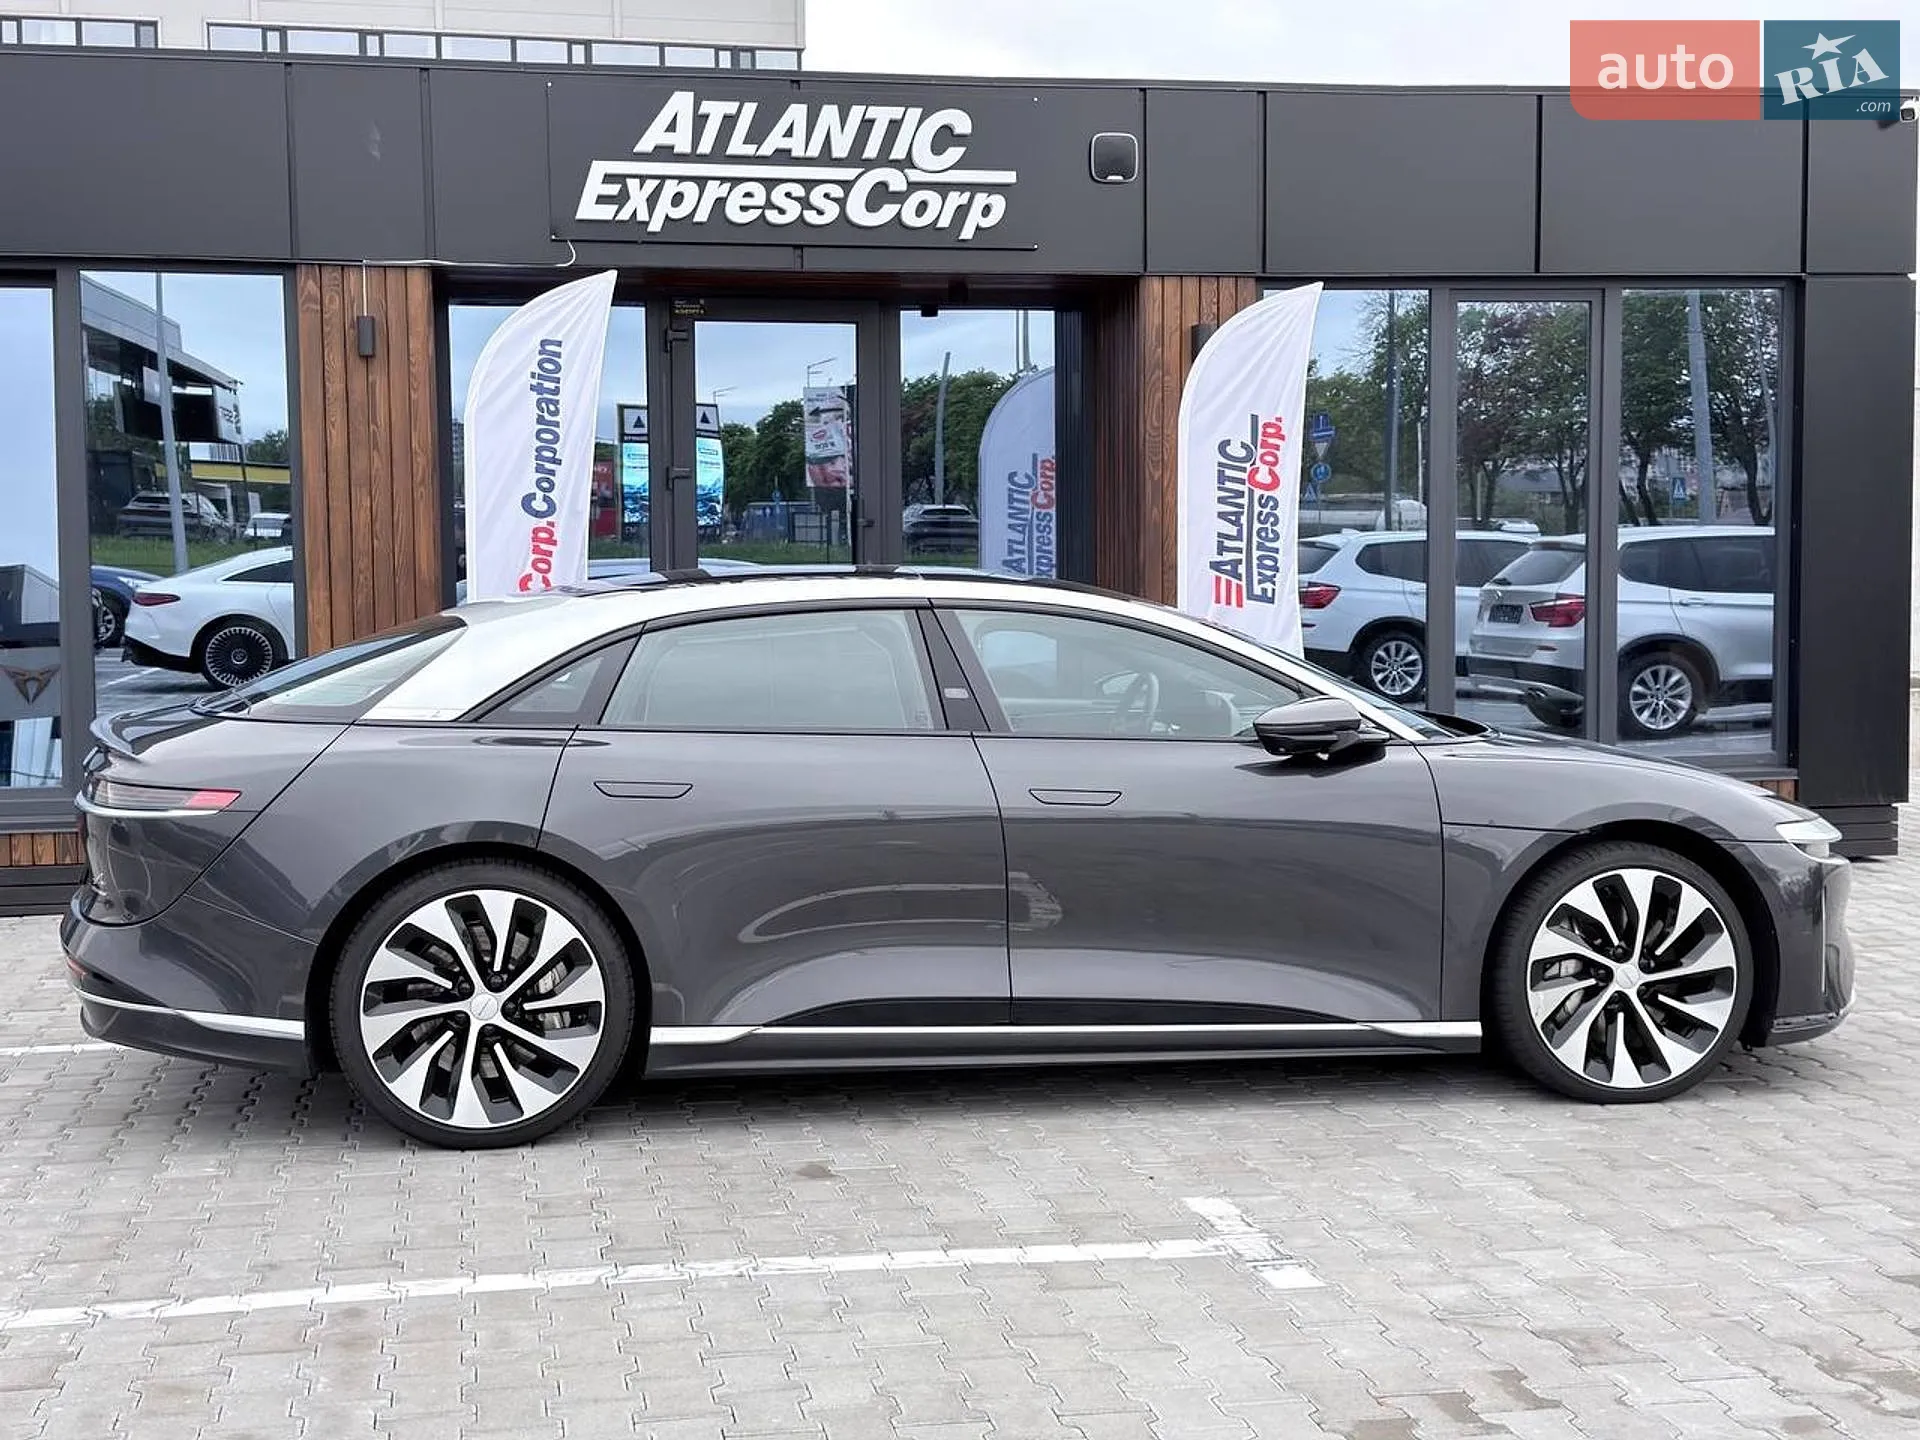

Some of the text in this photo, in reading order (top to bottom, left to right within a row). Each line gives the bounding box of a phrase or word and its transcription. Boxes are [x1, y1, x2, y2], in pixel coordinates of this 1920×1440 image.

[633, 91, 972, 173] ATLANTIC
[575, 160, 1007, 240] ExpressCorp
[1002, 471, 1035, 574] ATLANTIC
[1209, 438, 1255, 582] ATLANTIC
